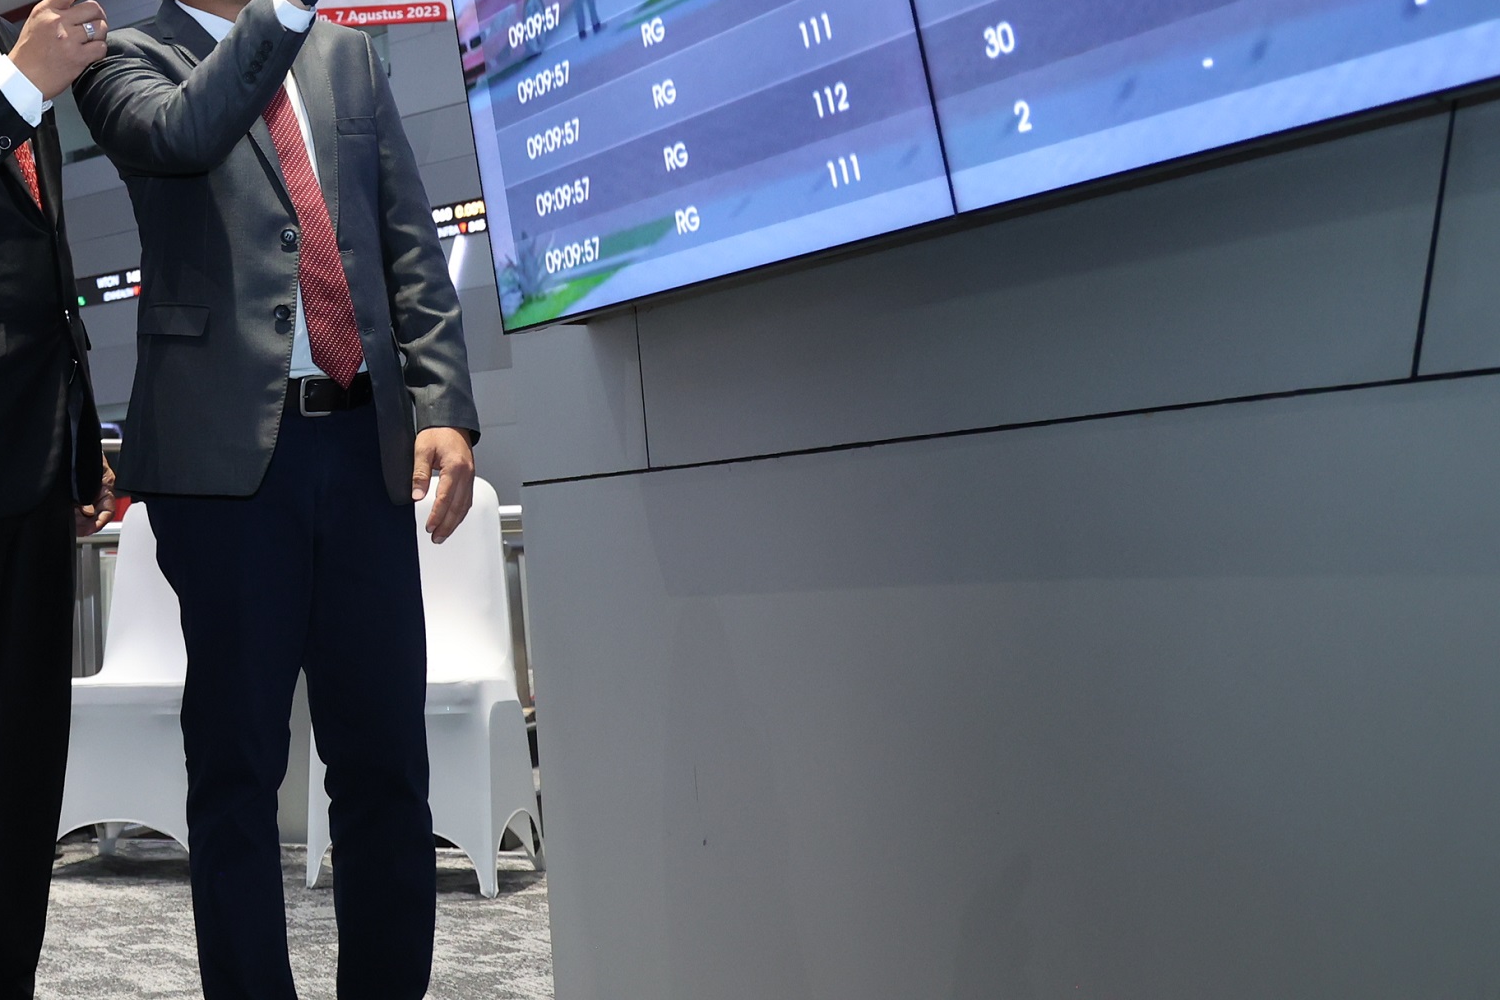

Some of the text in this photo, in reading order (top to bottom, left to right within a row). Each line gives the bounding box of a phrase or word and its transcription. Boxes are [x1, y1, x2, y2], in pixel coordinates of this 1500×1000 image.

[336, 11, 344, 22] 7
[347, 9, 404, 24] Agustus
[407, 6, 441, 18] 2023
[508, 3, 561, 48] 09:09:57
[517, 60, 570, 104] 09:09:57
[641, 18, 666, 49] RG
[526, 118, 580, 161] 09:09:57
[652, 79, 677, 110] RG
[799, 12, 832, 49] 111
[535, 21, 1016, 217] 09:09:57 RG 112 30
[545, 101, 1032, 274] 09:09:57 RG 111 2
